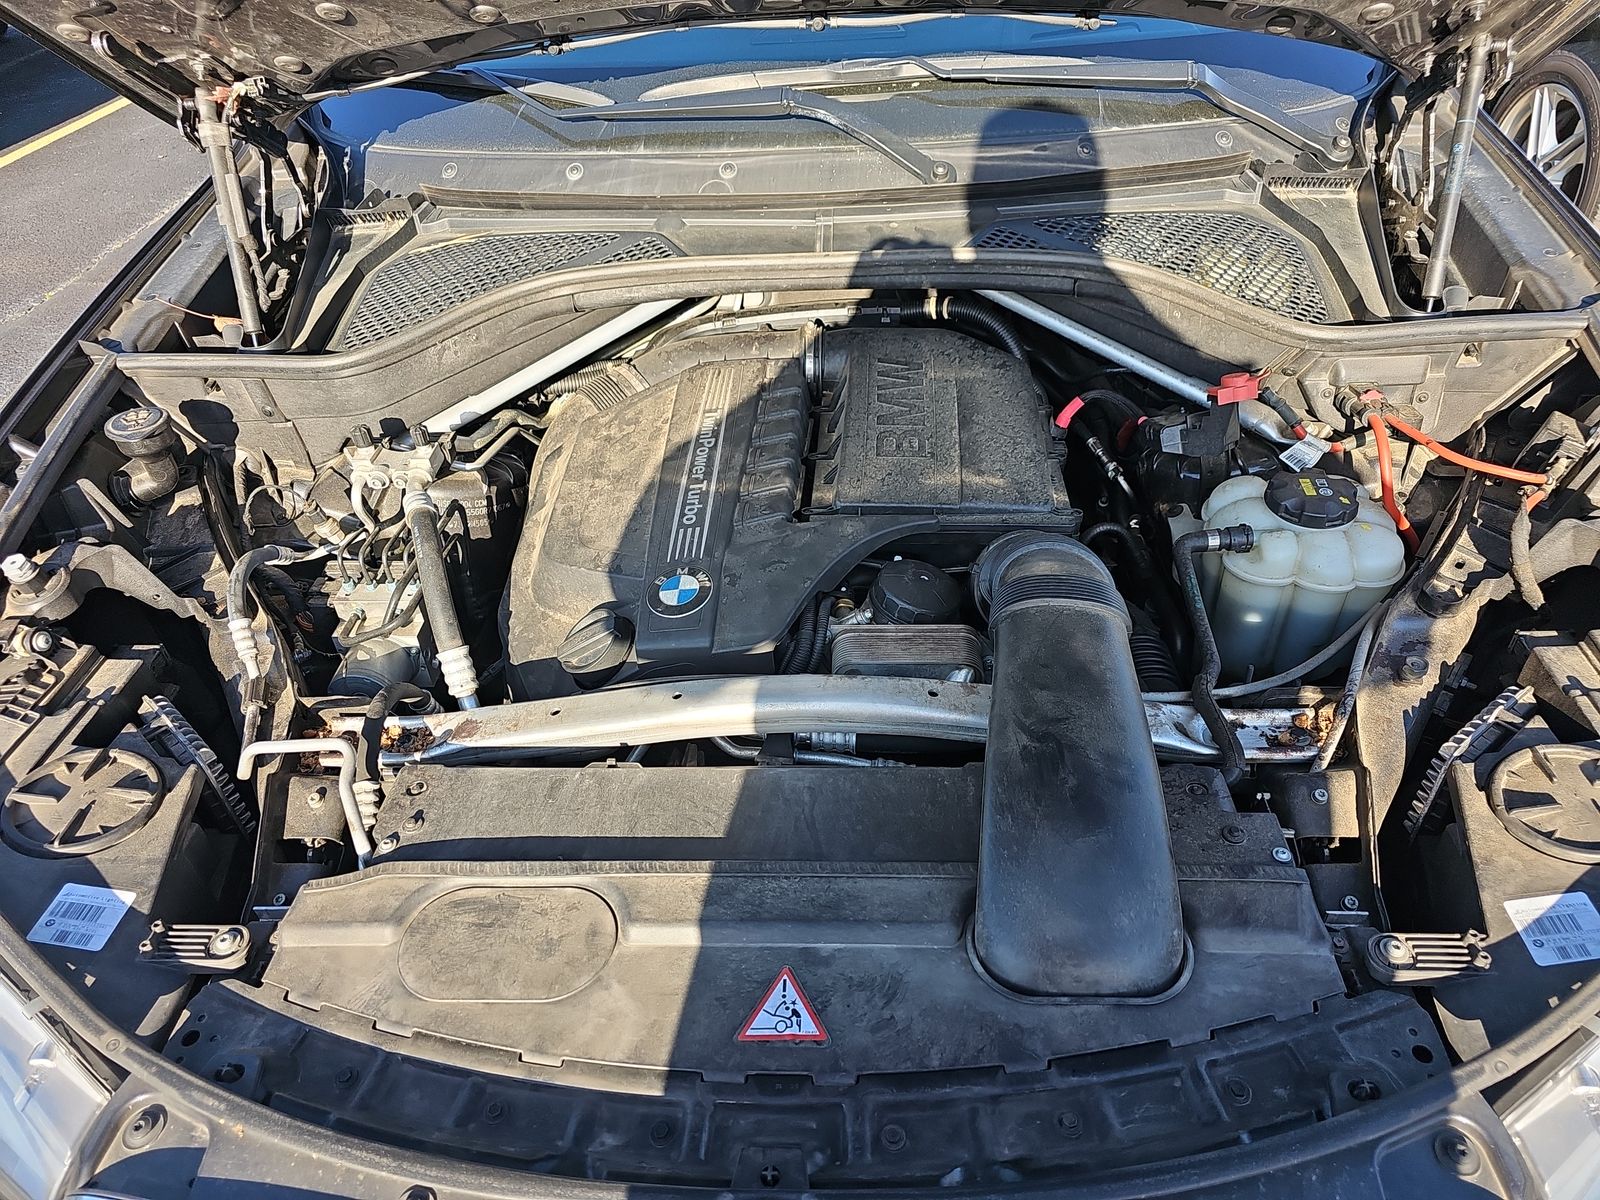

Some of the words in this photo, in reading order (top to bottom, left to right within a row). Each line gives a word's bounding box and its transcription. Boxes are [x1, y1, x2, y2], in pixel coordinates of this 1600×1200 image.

[876, 358, 927, 458] BMW
[692, 408, 722, 481] TwinPower
[683, 480, 708, 525] Turbo
[654, 567, 711, 587] BMW
